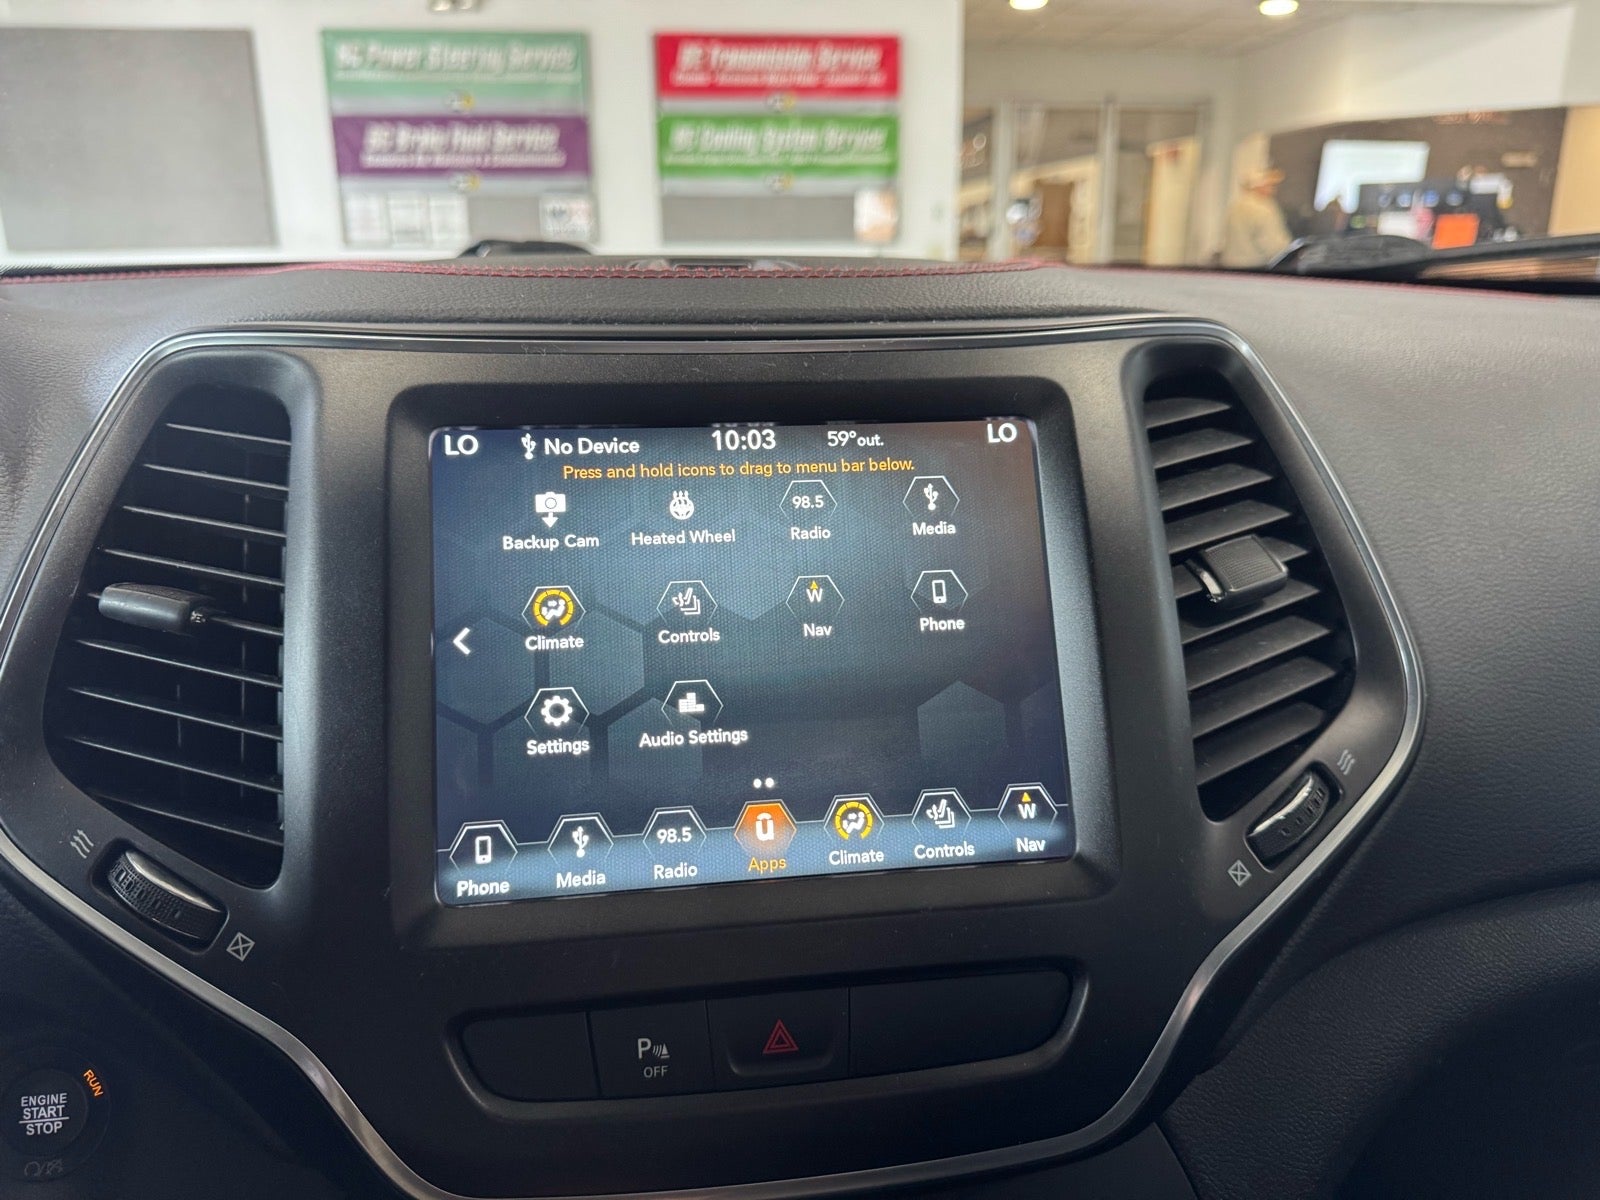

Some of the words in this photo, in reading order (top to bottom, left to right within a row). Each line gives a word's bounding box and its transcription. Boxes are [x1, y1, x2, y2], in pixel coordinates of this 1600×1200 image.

[507, 42, 577, 70] Service
[816, 43, 883, 69] Service
[493, 122, 560, 150] Service
[822, 123, 887, 150] Service
[712, 430, 776, 450] 10:03
[988, 423, 1017, 443] LO
[445, 435, 478, 456] LO
[545, 439, 573, 455] No
[578, 437, 640, 454] Device
[563, 465, 602, 479] Press
[607, 465, 635, 478] and
[641, 463, 673, 477] hold
[678, 462, 716, 476] icons
[720, 463, 734, 476] to
[740, 461, 772, 477] drag
[776, 462, 791, 474] to
[796, 462, 836, 474] menu
[842, 459, 864, 472] bar
[870, 458, 914, 471] below.
[792, 496, 824, 508] 98.5
[791, 526, 831, 540] Radio
[913, 522, 956, 535] Media
[503, 536, 559, 551] Backup
[565, 535, 599, 548] Cam
[632, 532, 685, 546] Heated
[690, 529, 736, 543] Wheel
[806, 588, 823, 602] W
[804, 624, 832, 637] Nav
[920, 618, 965, 632] Phone
[525, 636, 584, 650] Climate
[658, 628, 720, 644] Controls
[639, 732, 684, 748] Audio
[688, 729, 748, 744] Settings
[526, 740, 590, 756] Settings
[1018, 804, 1036, 820] W
[656, 828, 692, 844] 98.5
[914, 842, 975, 859] Controls
[1016, 838, 1046, 852] Nav
[748, 857, 786, 875] Apps
[829, 850, 884, 866] Climate
[654, 863, 698, 879] Radio
[556, 872, 606, 888] Media
[456, 880, 510, 897] Phone
[638, 1038, 651, 1059] P
[644, 1065, 668, 1078] OFF
[83, 1069, 104, 1097] RUN
[21, 1093, 68, 1107] ENGINE
[23, 1105, 65, 1120] START
[26, 1121, 62, 1136] STOP
